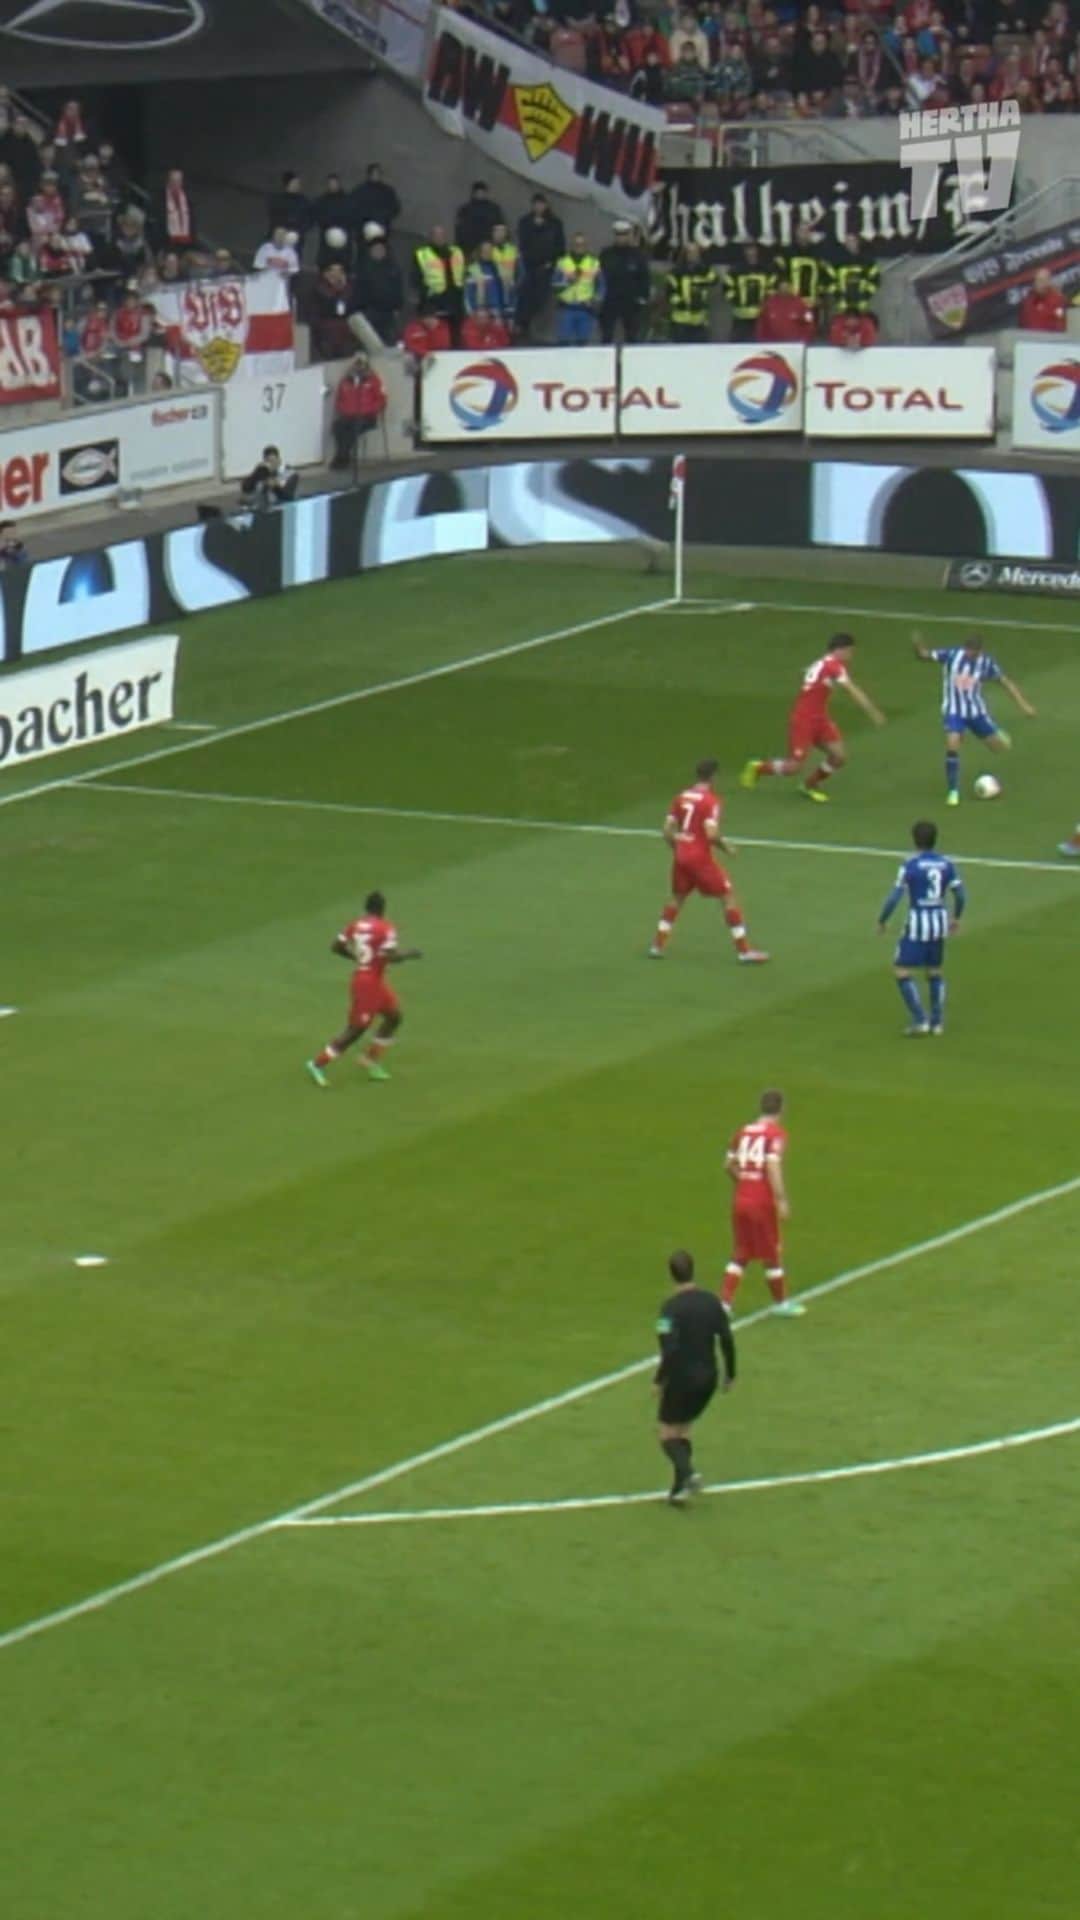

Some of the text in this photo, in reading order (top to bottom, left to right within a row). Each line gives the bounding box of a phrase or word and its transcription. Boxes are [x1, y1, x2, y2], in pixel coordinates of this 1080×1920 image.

[262, 383, 286, 413] 37
[533, 382, 680, 412] TOTAL
[815, 381, 963, 411] TOTAL
[0, 452, 49, 508] er
[681, 802, 696, 832] 7
[927, 868, 943, 900] 3
